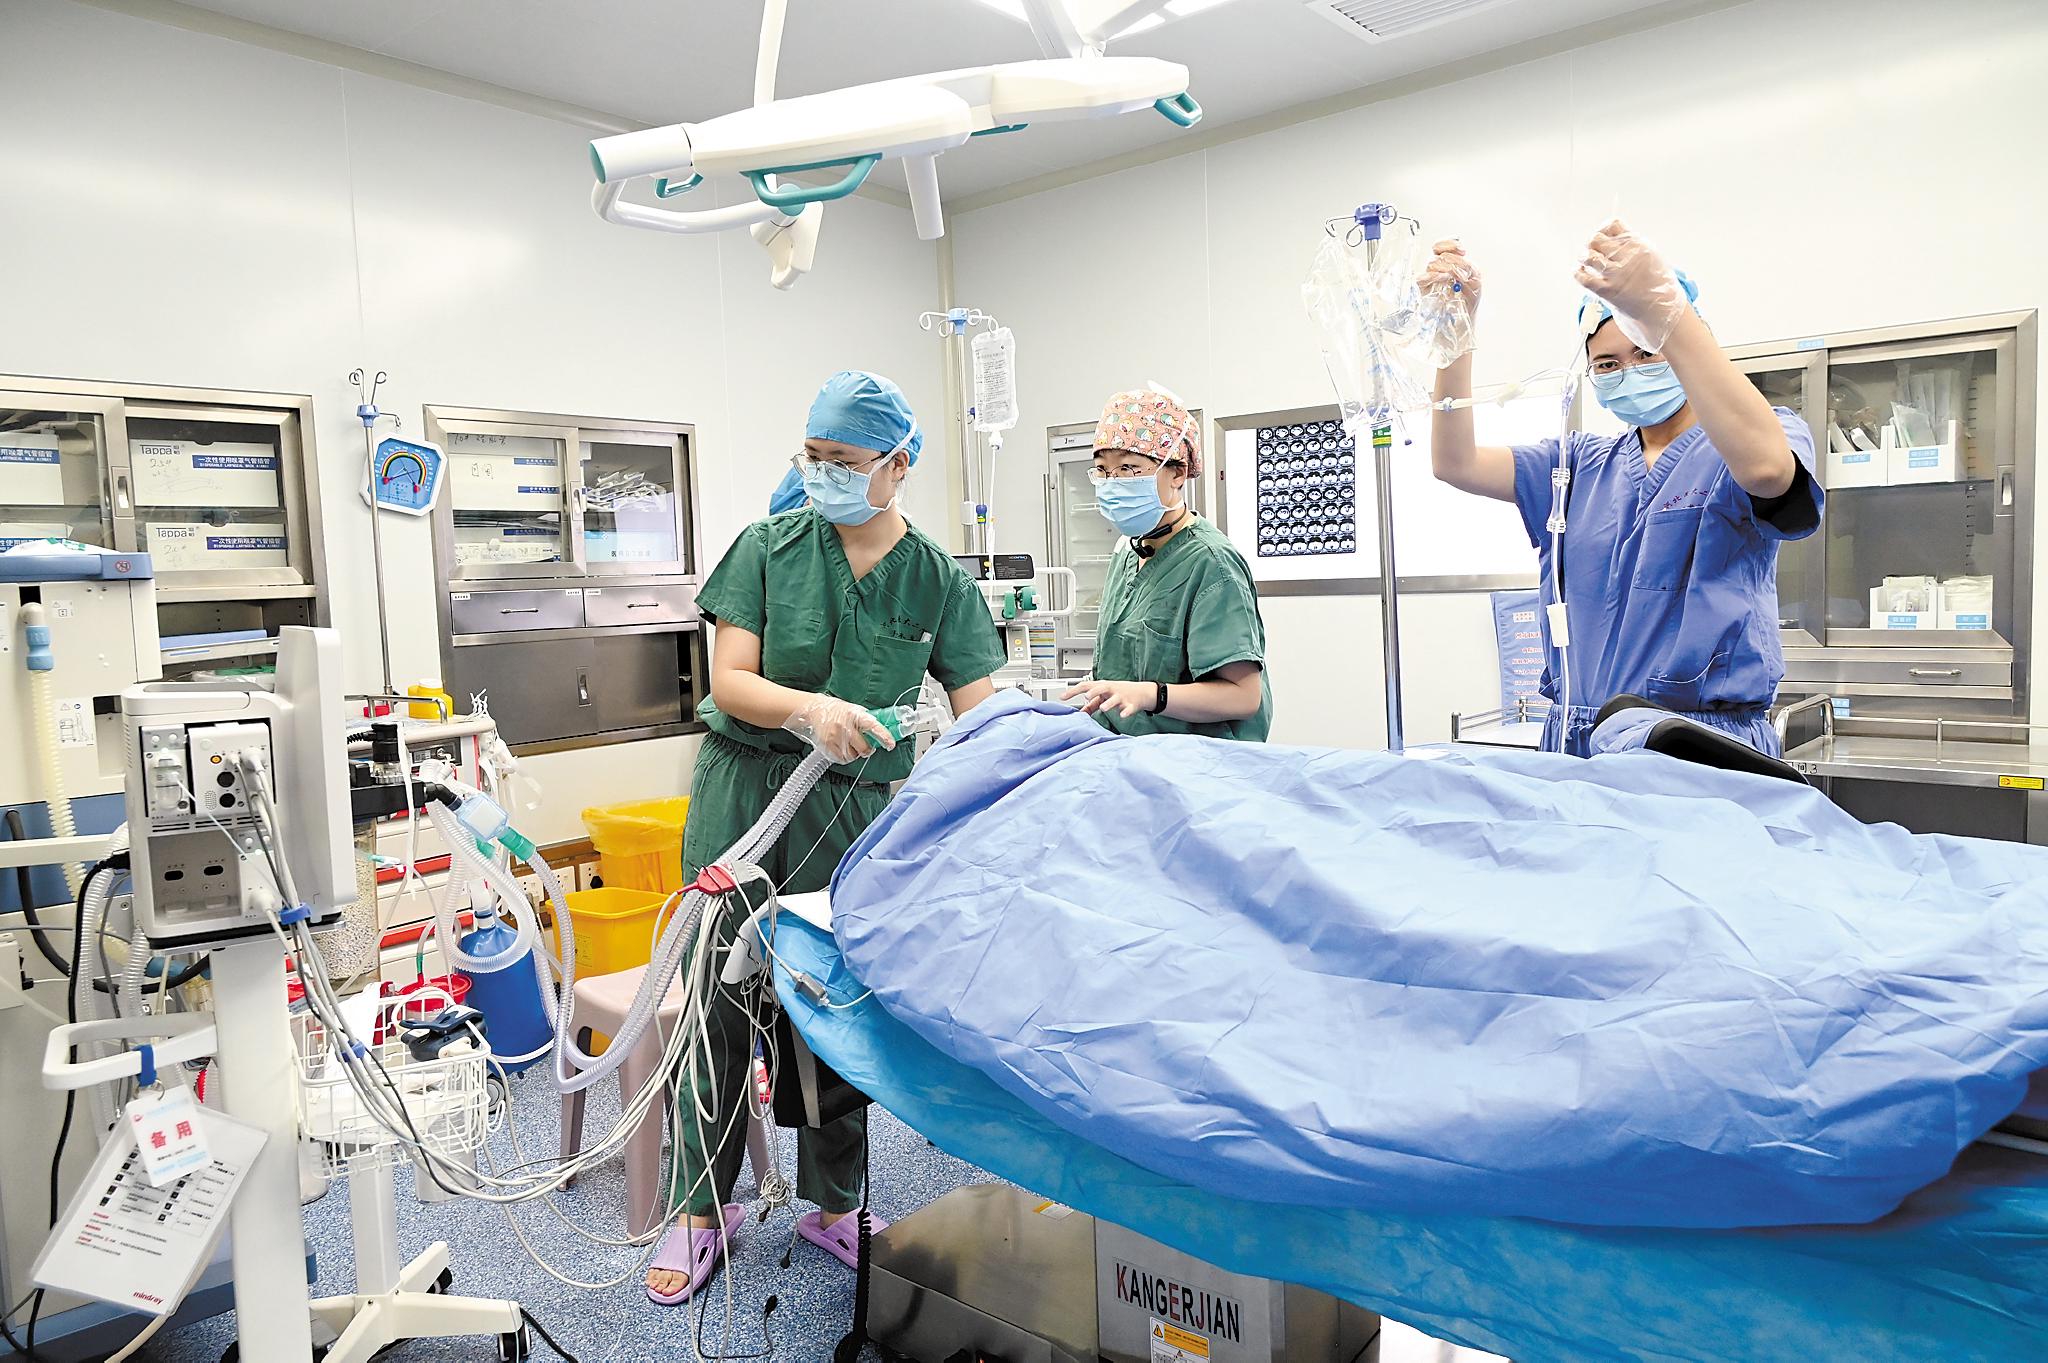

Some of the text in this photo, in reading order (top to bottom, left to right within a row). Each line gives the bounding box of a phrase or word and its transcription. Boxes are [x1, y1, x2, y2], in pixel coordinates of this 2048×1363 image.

[140, 444, 172, 456] Tappa
[156, 527, 188, 538] Tappa
[151, 1120, 193, 1149] 备用
[1116, 1262, 1240, 1343] KANGERJIAN
